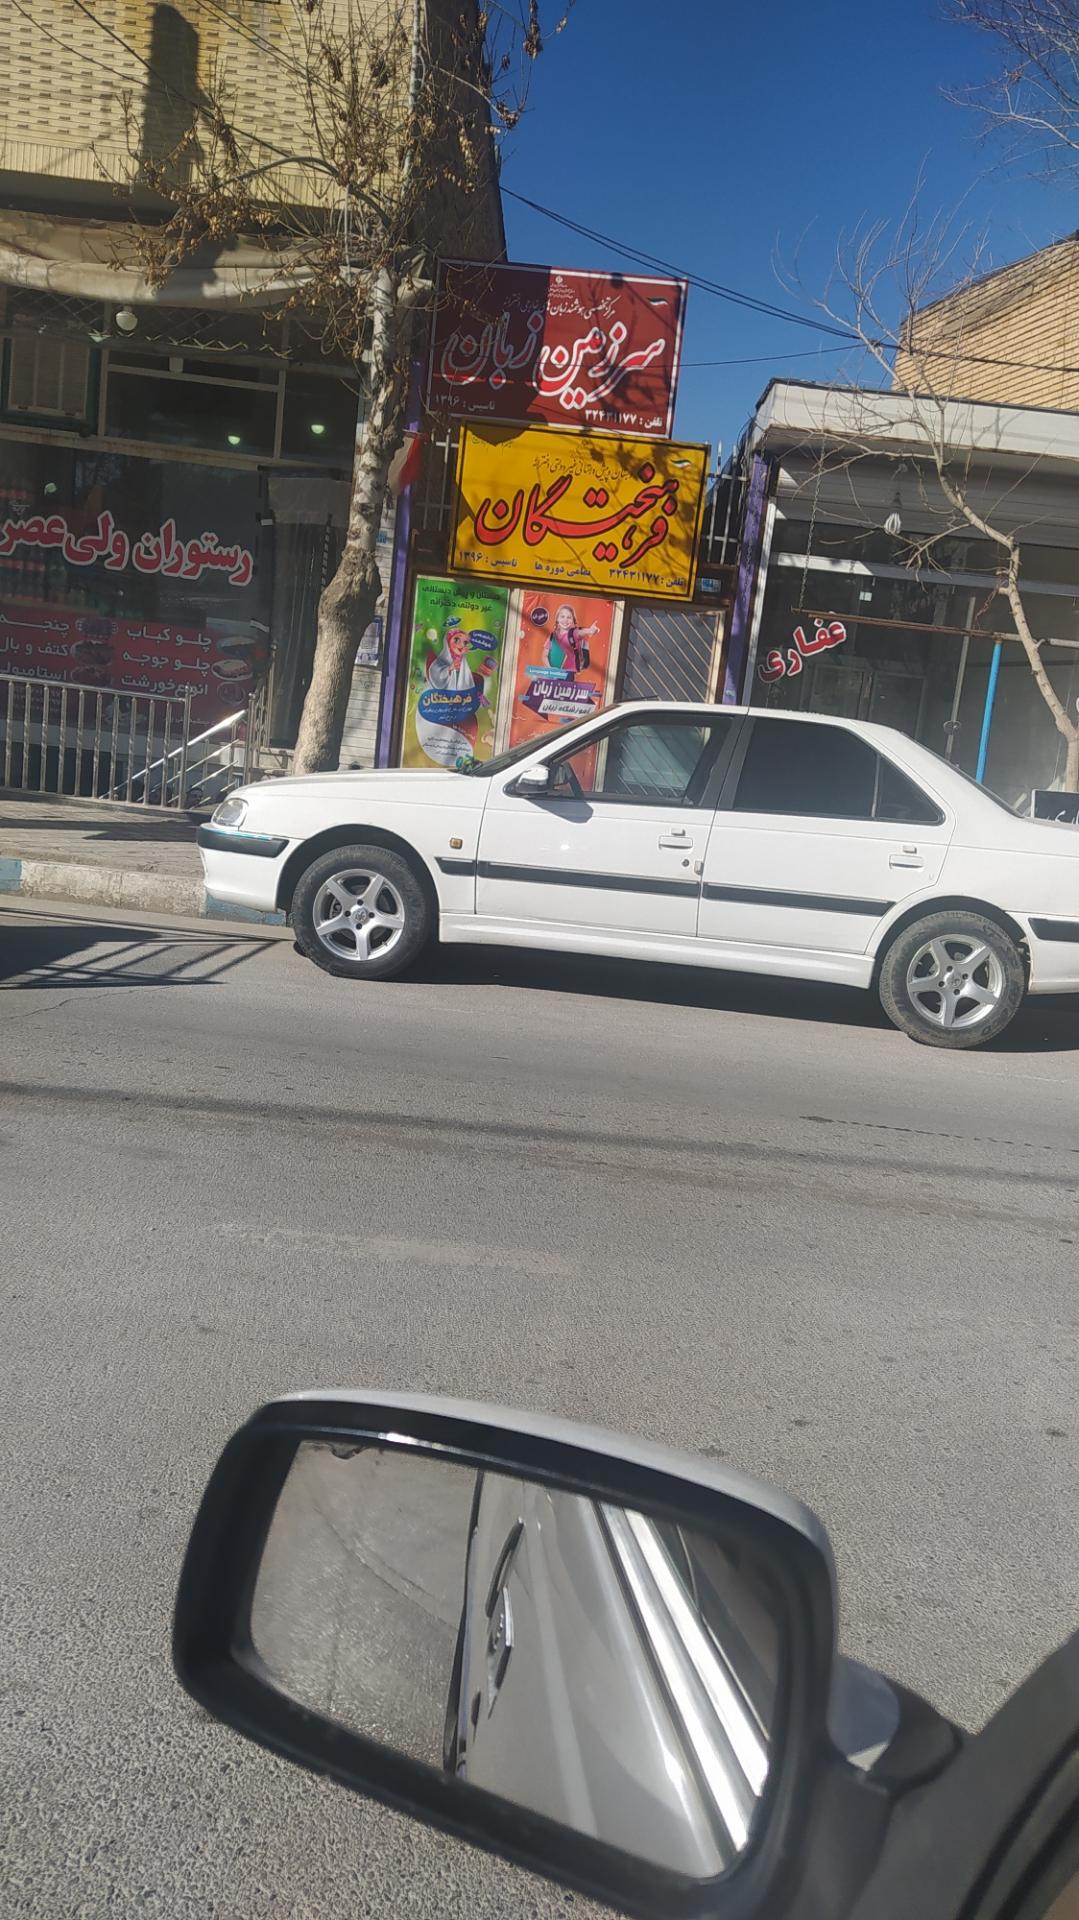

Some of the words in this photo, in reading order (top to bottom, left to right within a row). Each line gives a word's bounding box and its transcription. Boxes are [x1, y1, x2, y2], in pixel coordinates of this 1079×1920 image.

[441, 310, 545, 390] زبان
[532, 321, 666, 410] سرزمین
[585, 409, 637, 424] ۳۲۴۳۱۱۷۷
[474, 462, 680, 568] فرهیختگان
[0, 514, 67, 556] عصر
[63, 510, 129, 571] ولی
[133, 518, 253, 586] رستوران
[458, 550, 483, 564] ۱۳۹۶
[534, 560, 545, 571] ها
[546, 564, 565, 577] دوره
[566, 566, 592, 579] تمامی
[608, 568, 660, 585] ۳۲۴۳۱۱۷۷
[126, 625, 171, 644] کباب
[175, 633, 213, 653] چلو
[25, 643, 33, 656] و
[37, 641, 69, 657] کتف
[122, 650, 169, 670] جوجه
[173, 657, 211, 678] چلو
[121, 674, 176, 694] خورشت
[533, 680, 553, 698] زبان
[553, 684, 589, 701] سرزمین
[422, 692, 472, 706] فرهیختگان
[543, 703, 558, 712] زبان
